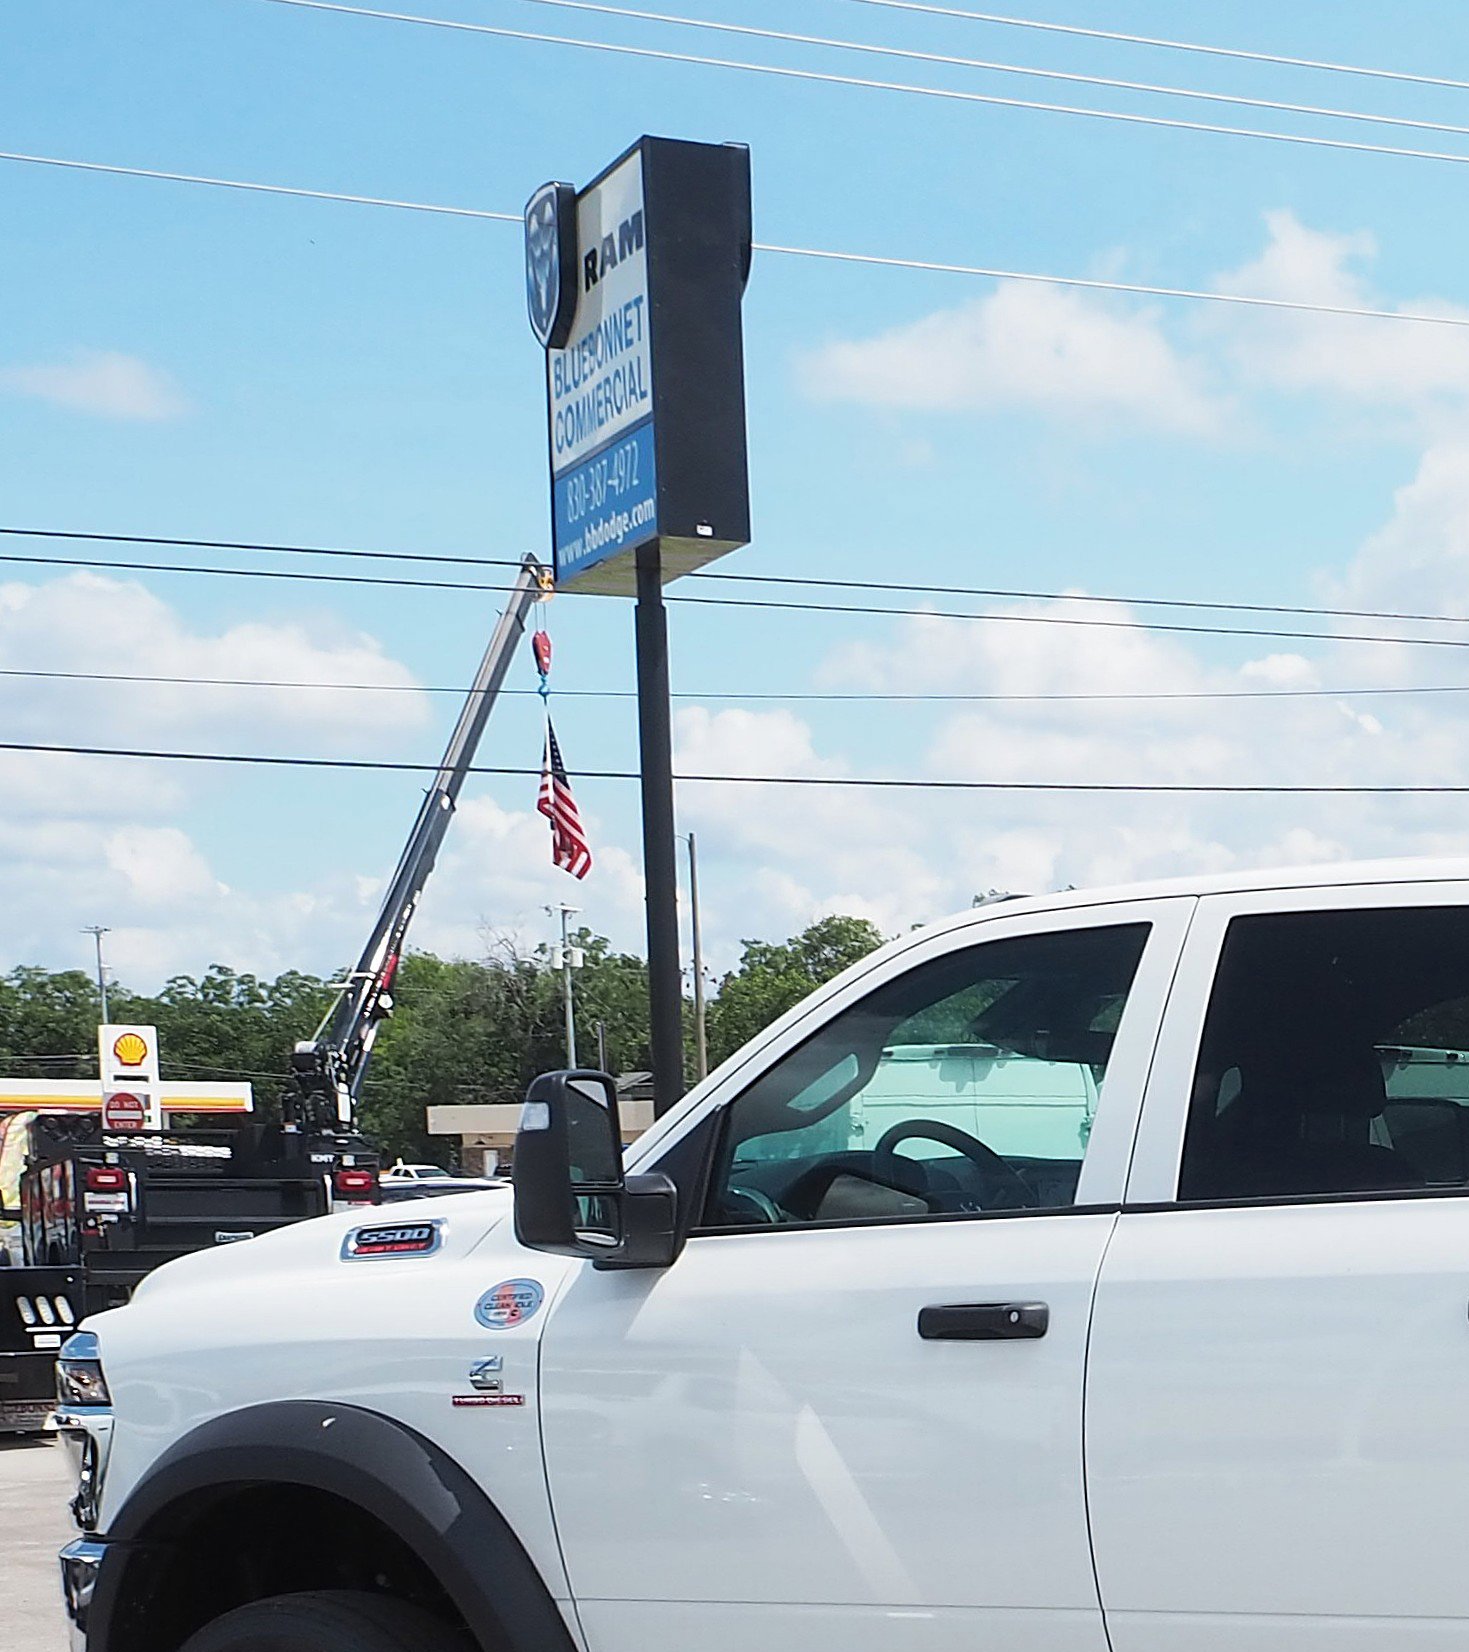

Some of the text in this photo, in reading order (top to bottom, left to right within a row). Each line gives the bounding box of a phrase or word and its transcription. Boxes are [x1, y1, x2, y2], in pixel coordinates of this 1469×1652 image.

[584, 209, 643, 293] RAM
[554, 295, 644, 399] BLUEBONNET
[556, 356, 648, 454] COMMERCIAL
[567, 440, 639, 523] 830-387-4972
[558, 498, 655, 566] www.bbdodge.com
[358, 1227, 431, 1244] 5500
